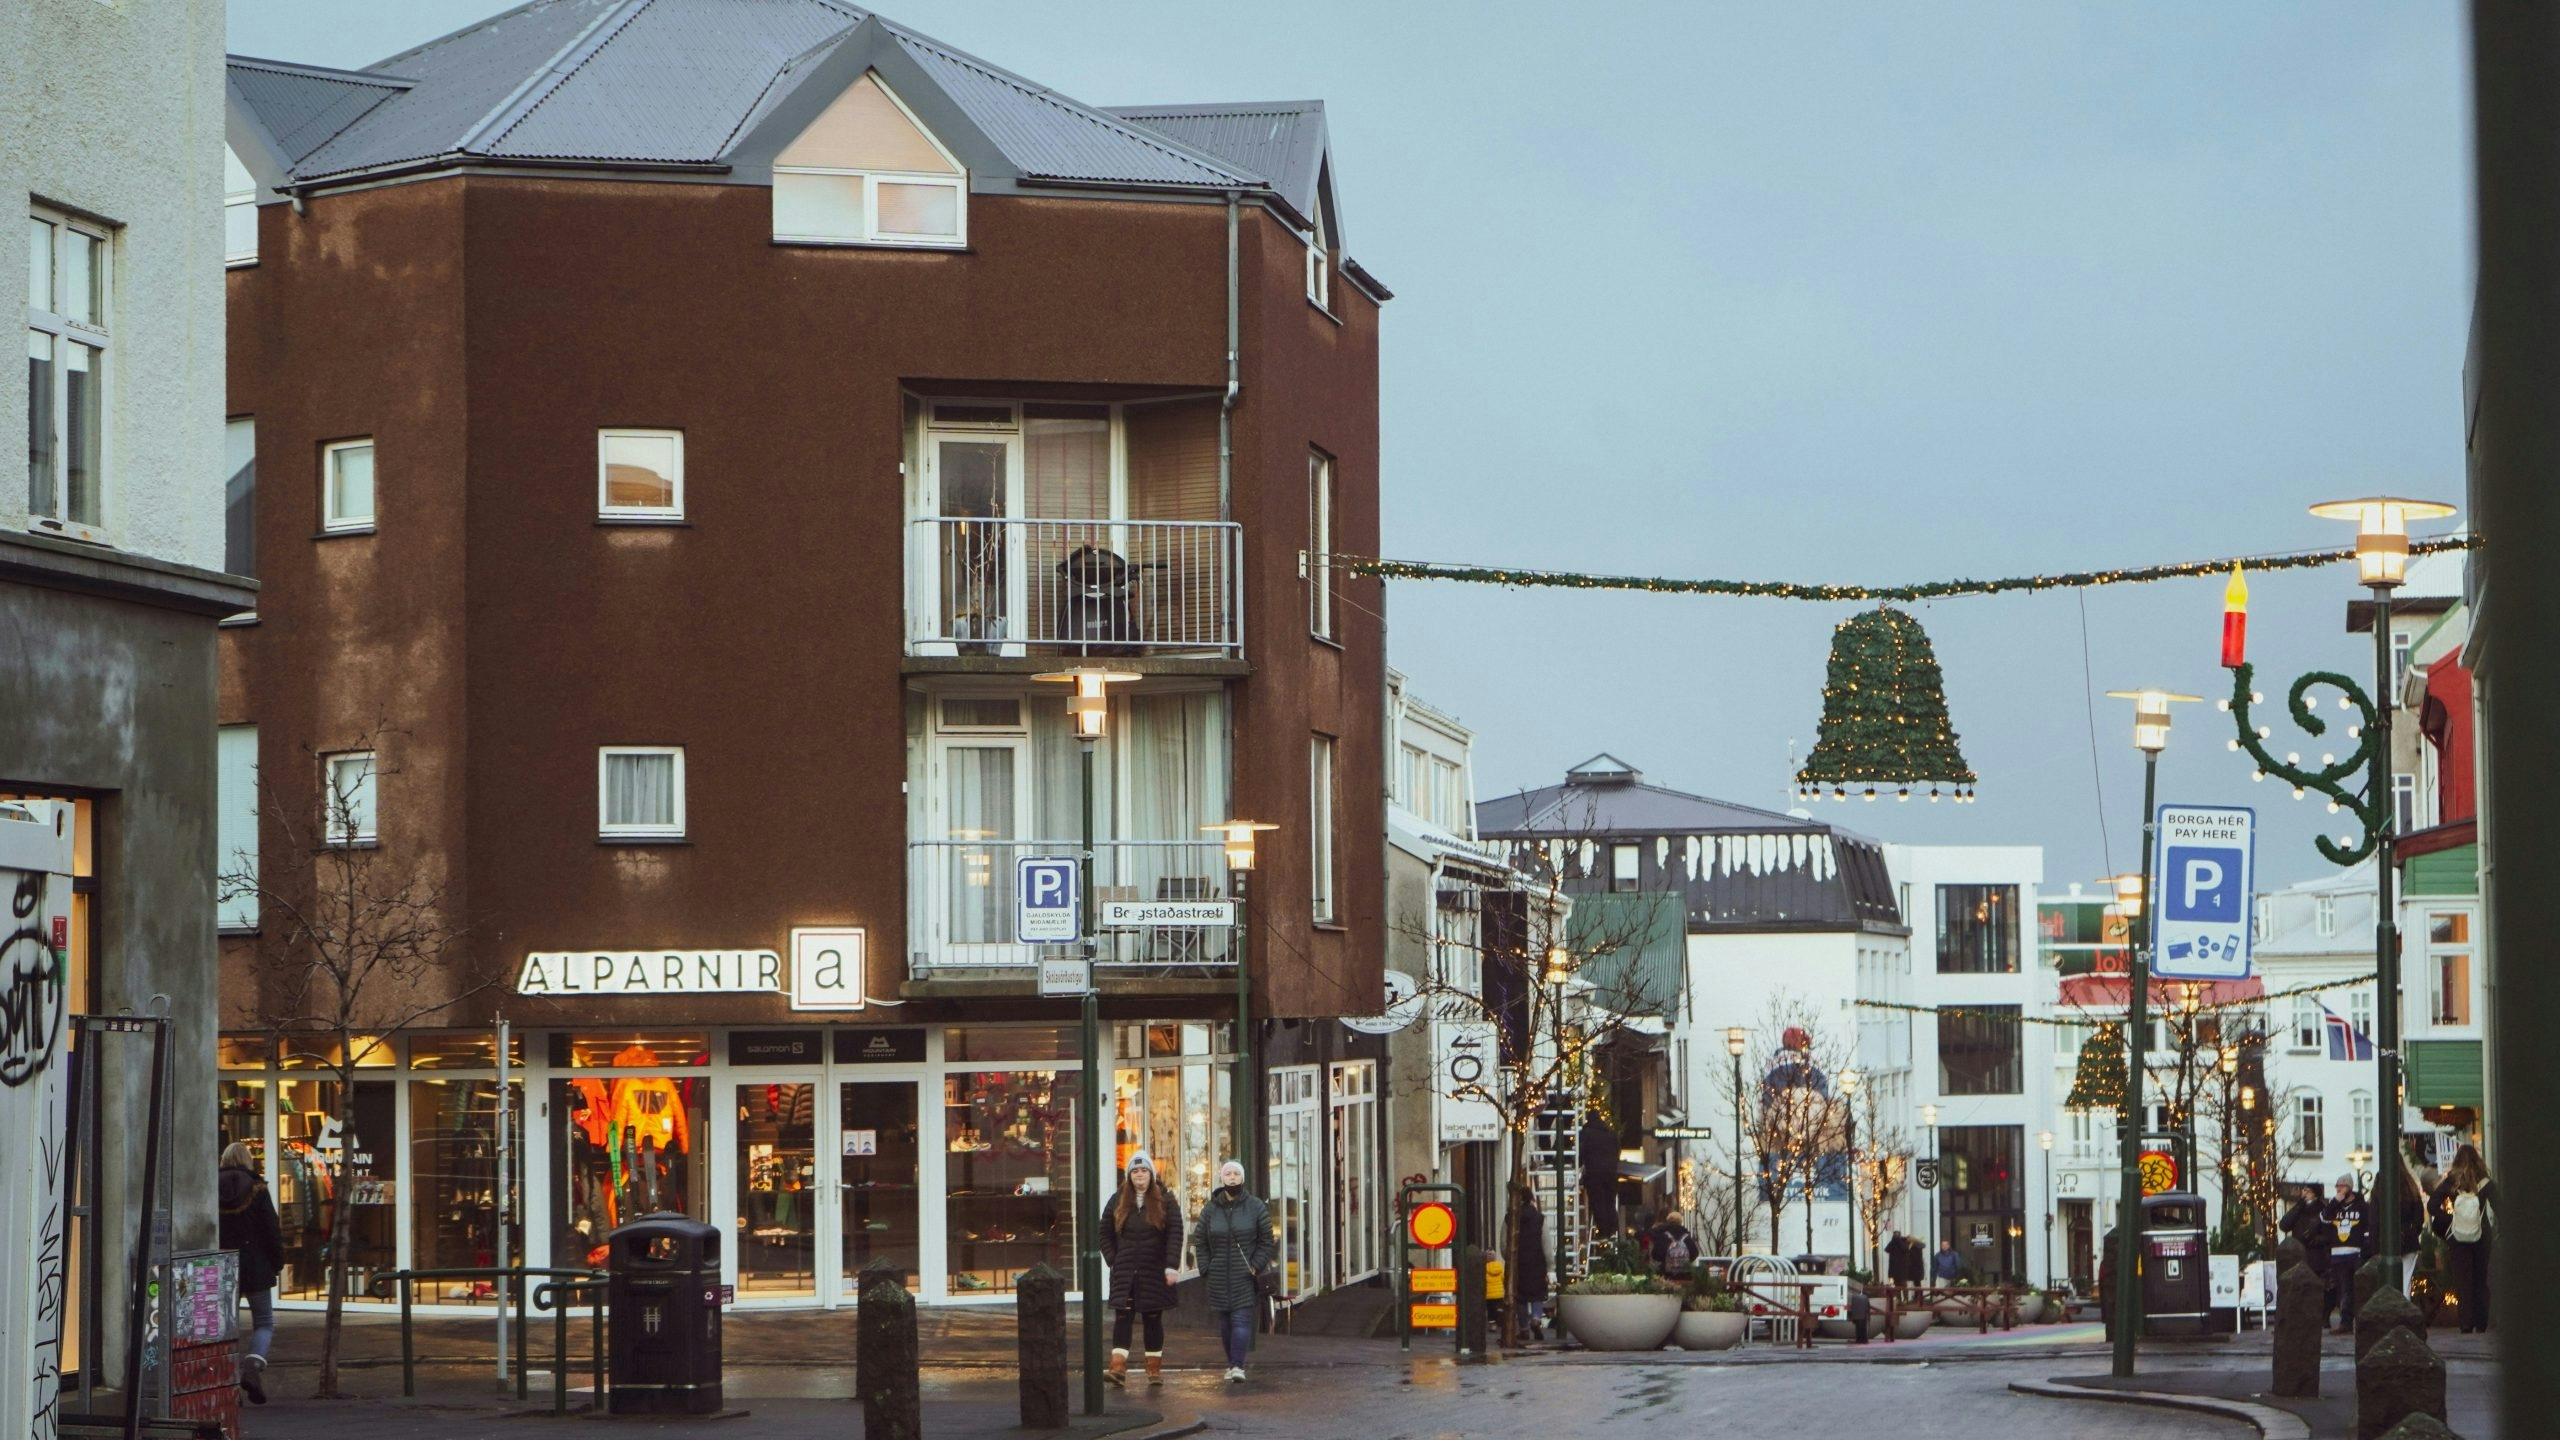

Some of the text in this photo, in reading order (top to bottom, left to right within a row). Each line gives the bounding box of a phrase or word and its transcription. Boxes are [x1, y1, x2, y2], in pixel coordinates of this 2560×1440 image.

[2168, 814, 2244, 826] BORGA HÉR
[2175, 828, 2237, 840] PAY HERE
[523, 949, 845, 991] ALPARNIR a
[1679, 1128, 1696, 1138] fine
[1697, 1129, 1710, 1137] art
